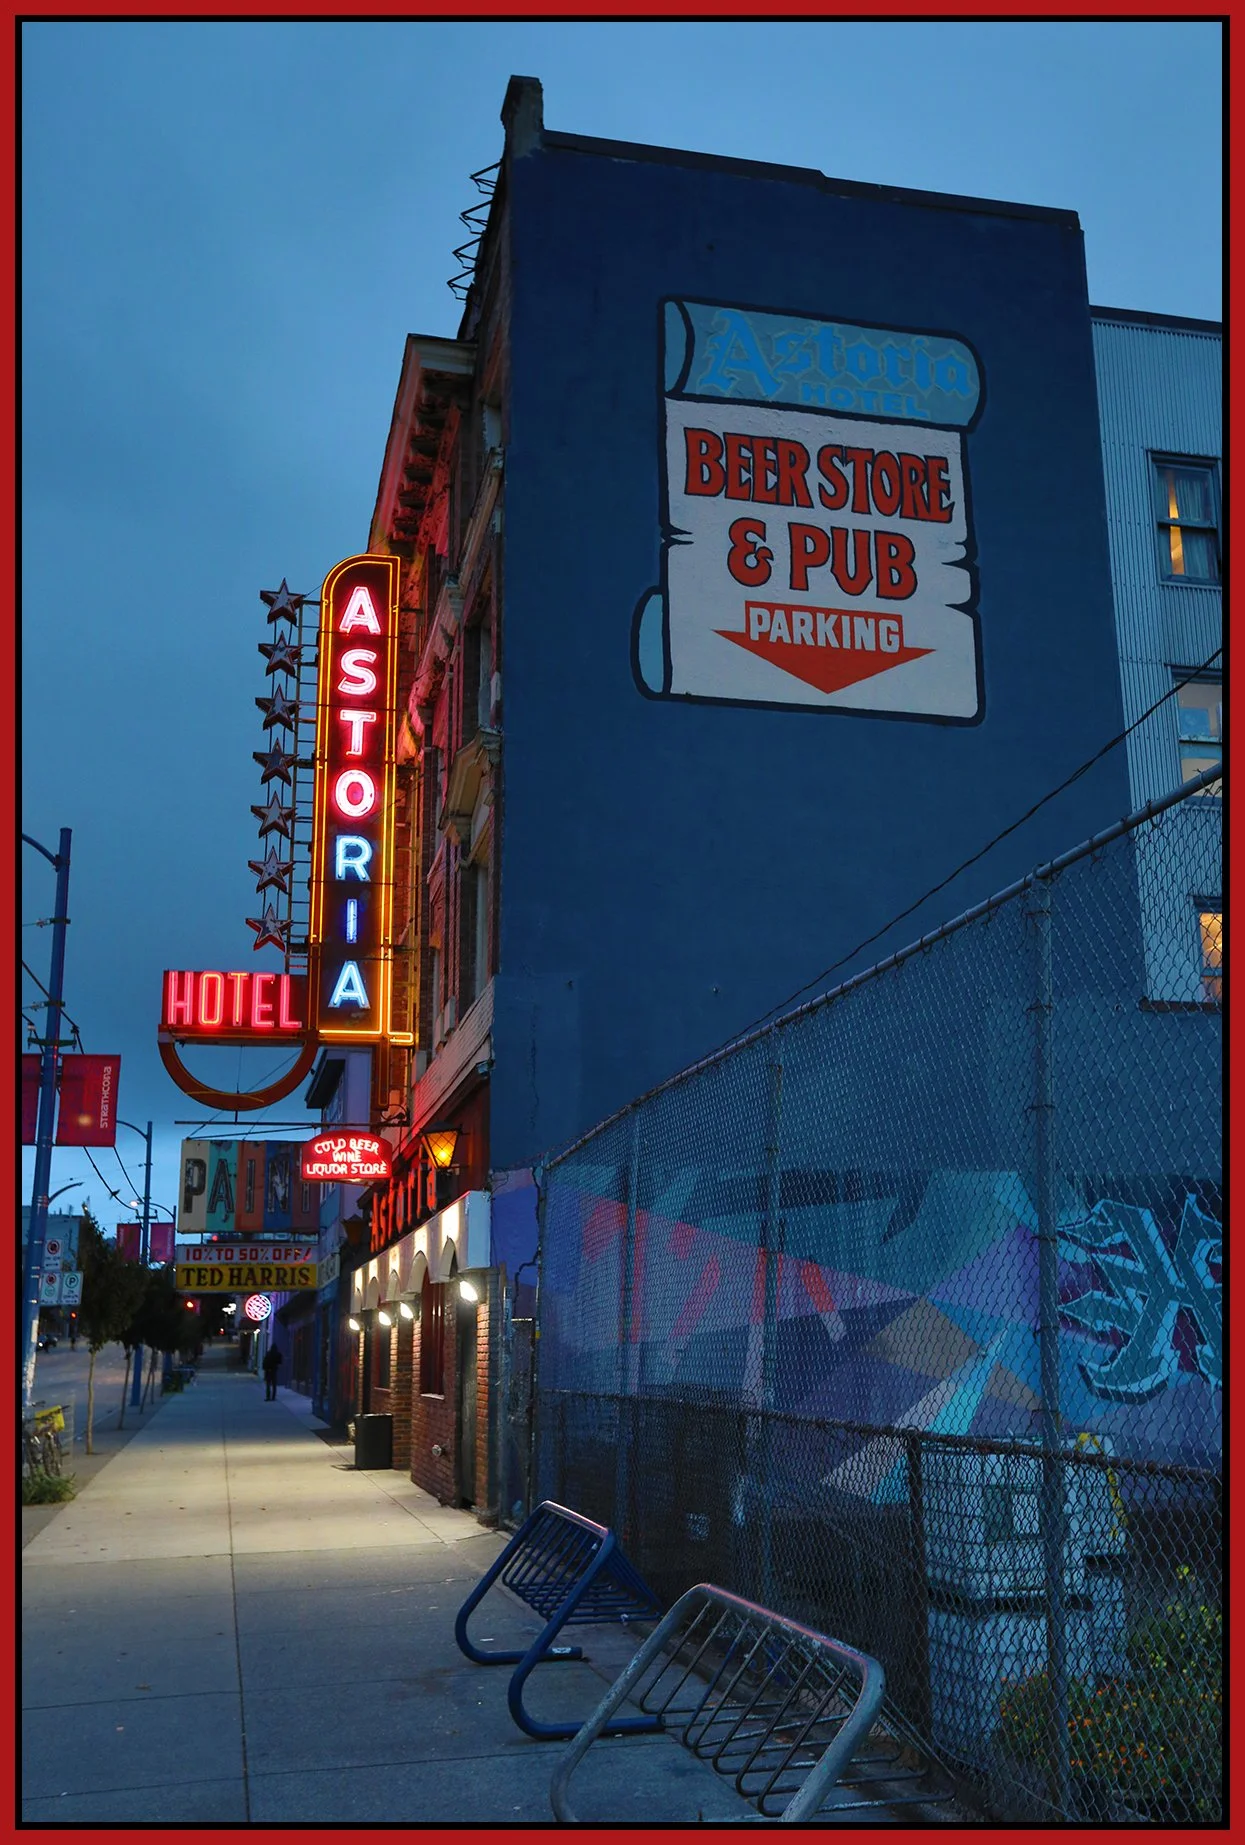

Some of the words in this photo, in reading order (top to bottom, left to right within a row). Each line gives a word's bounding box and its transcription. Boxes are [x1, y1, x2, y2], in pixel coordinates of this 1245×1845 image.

[698, 308, 978, 402] Astoria
[802, 381, 931, 419] HOTEL
[684, 427, 814, 509] BEER
[817, 443, 955, 524] STORE
[727, 517, 774, 587] &
[788, 521, 918, 600] PUB
[749, 607, 900, 653] PARKING
[328, 586, 381, 1010] ASTORIA
[167, 970, 302, 1029] HOTEL
[314, 1138, 346, 1154] COLD
[349, 1138, 379, 1155] BEER
[332, 1151, 362, 1162] WINE
[306, 1163, 348, 1176] LIQUOR
[350, 1163, 387, 1174] STORE
[239, 1248, 269, 1261] 50%
[181, 1267, 224, 1287] TED
[228, 1267, 311, 1287] HARRIS
